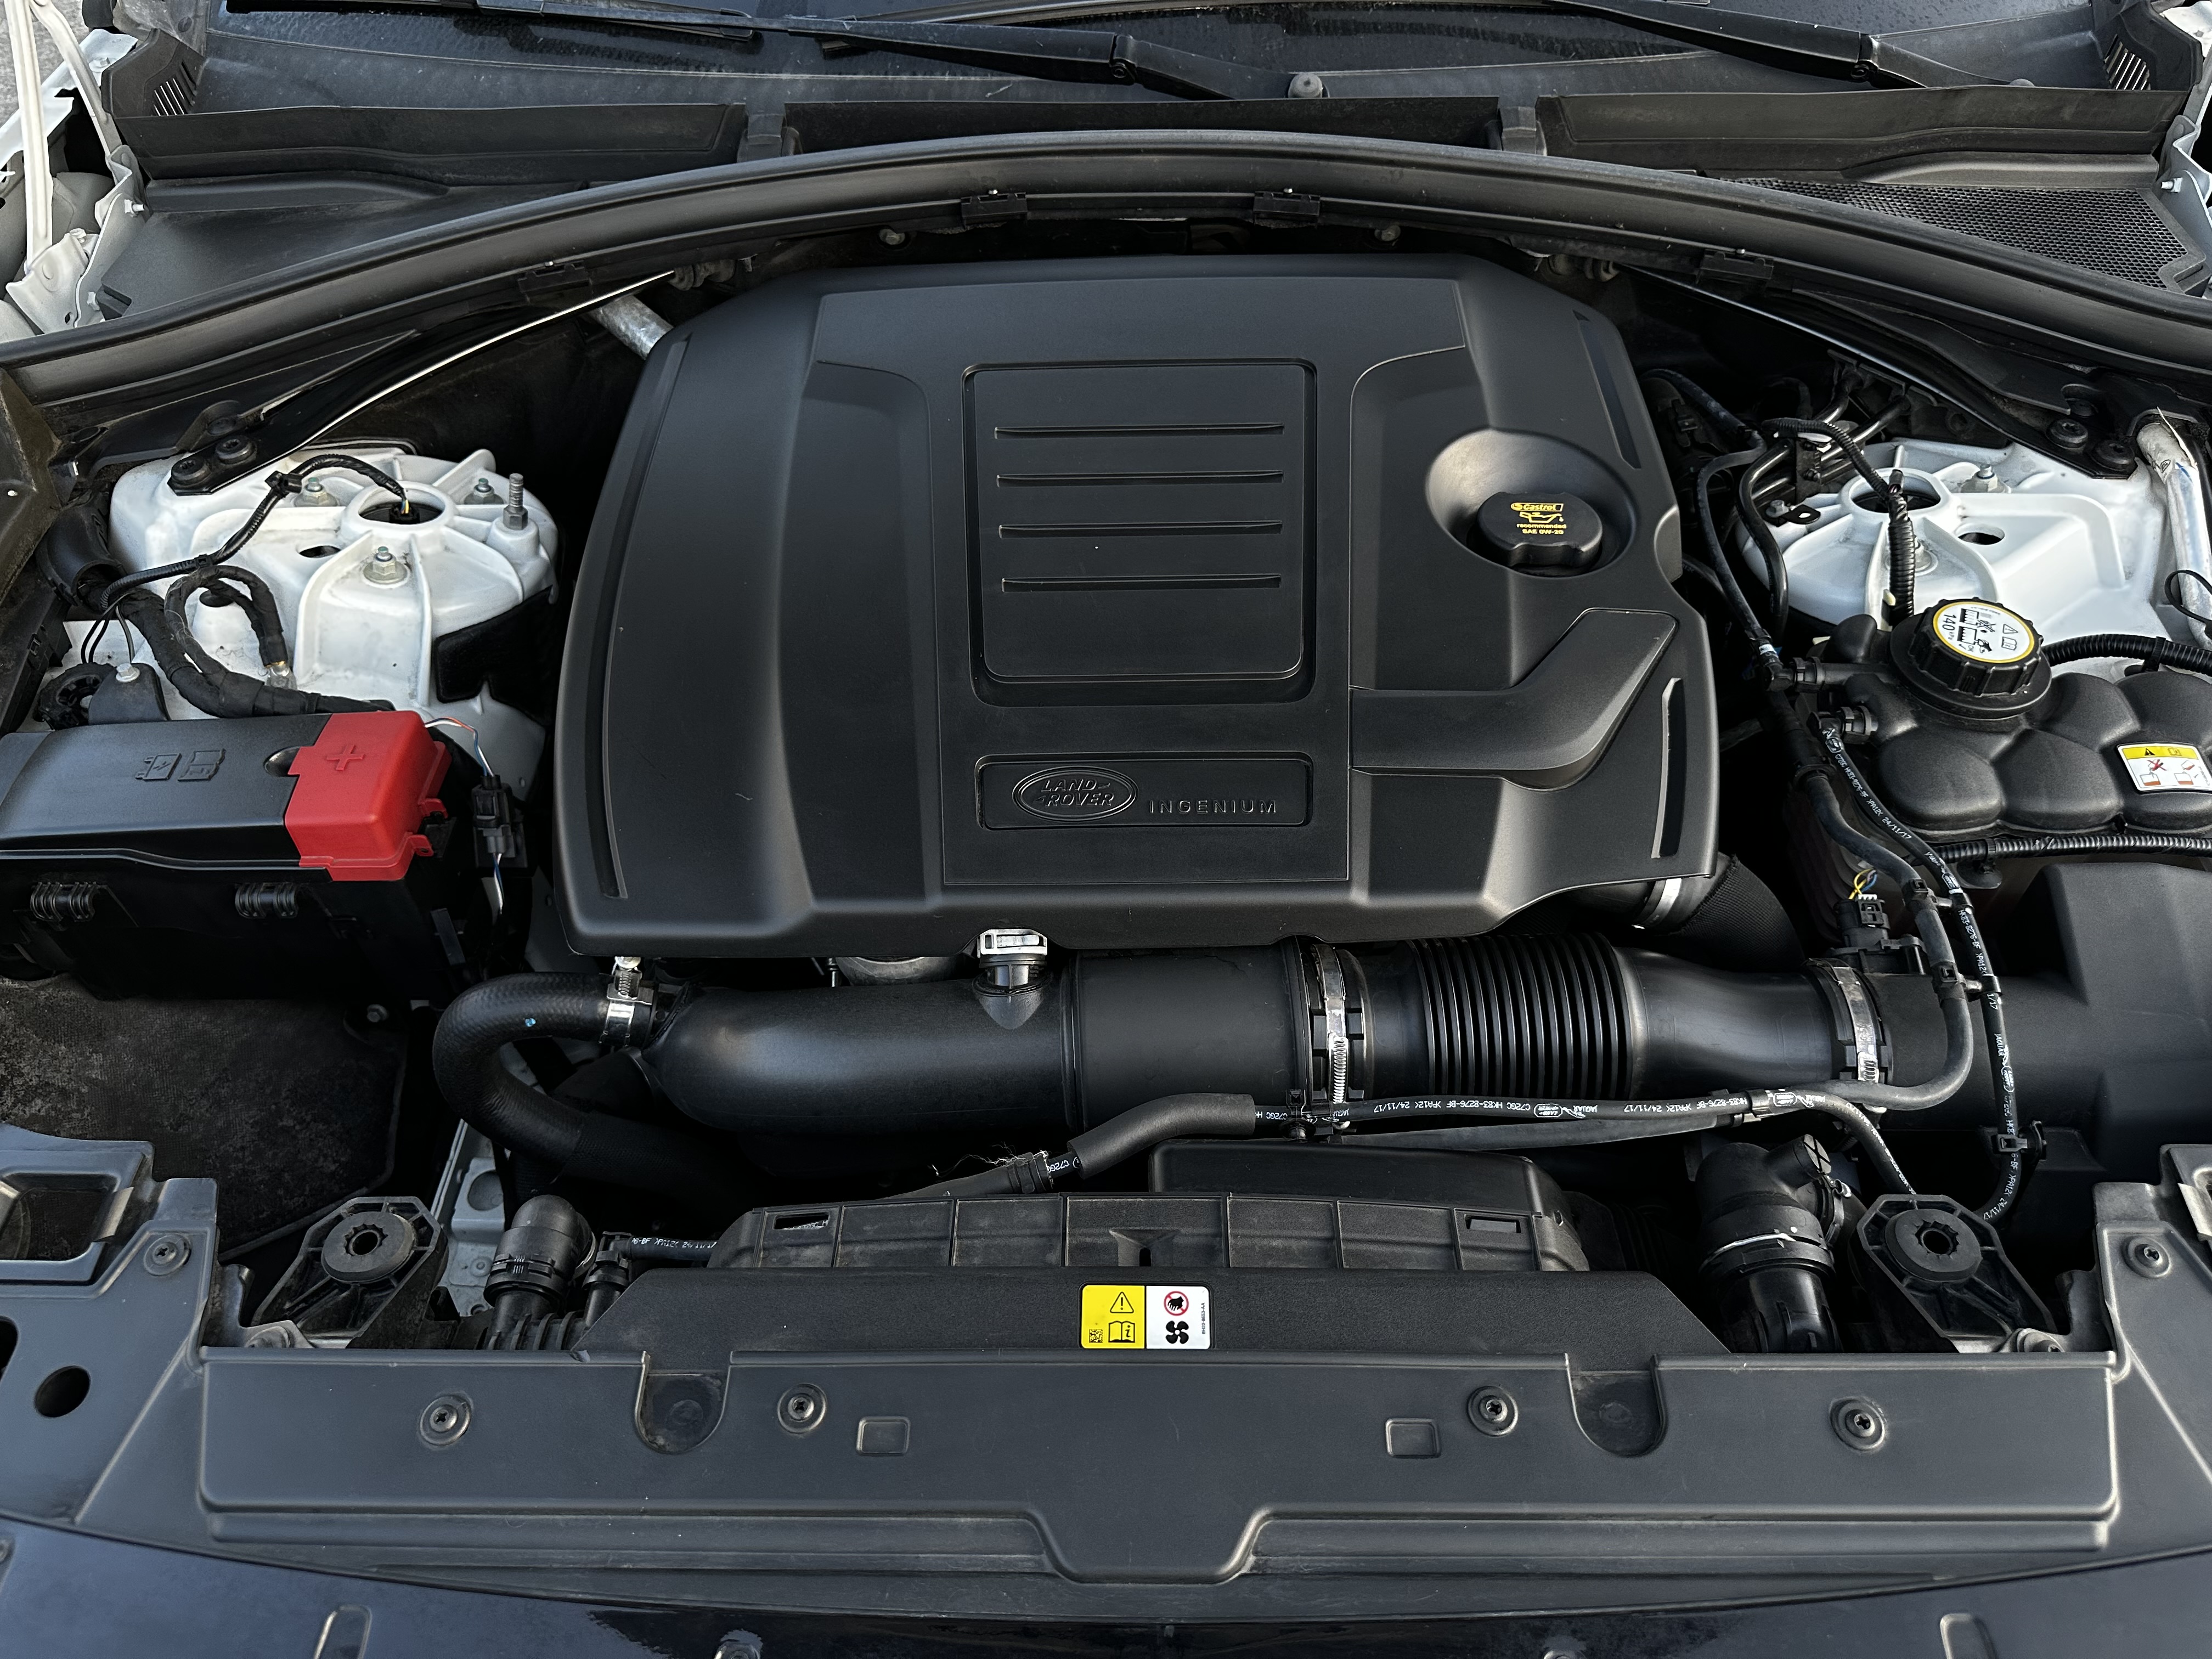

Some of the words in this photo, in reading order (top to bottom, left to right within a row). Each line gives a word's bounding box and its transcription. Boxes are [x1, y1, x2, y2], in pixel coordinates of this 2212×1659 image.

[1942, 614, 1956, 631] 140
[1041, 778, 1097, 792] LAND
[1045, 793, 1115, 808] ROVER
[1149, 800, 1278, 814] INGENIUM
[1882, 817, 1911, 838] 24/11/17
[1959, 908, 1982, 949] HK83-8276-BF
[1374, 1102, 1409, 1113] 24/11/17
[1446, 1101, 1503, 1109] HK83-8276-BF
[1506, 1102, 1531, 1111] C72GC
[1624, 1105, 1662, 1113] 24/11/17
